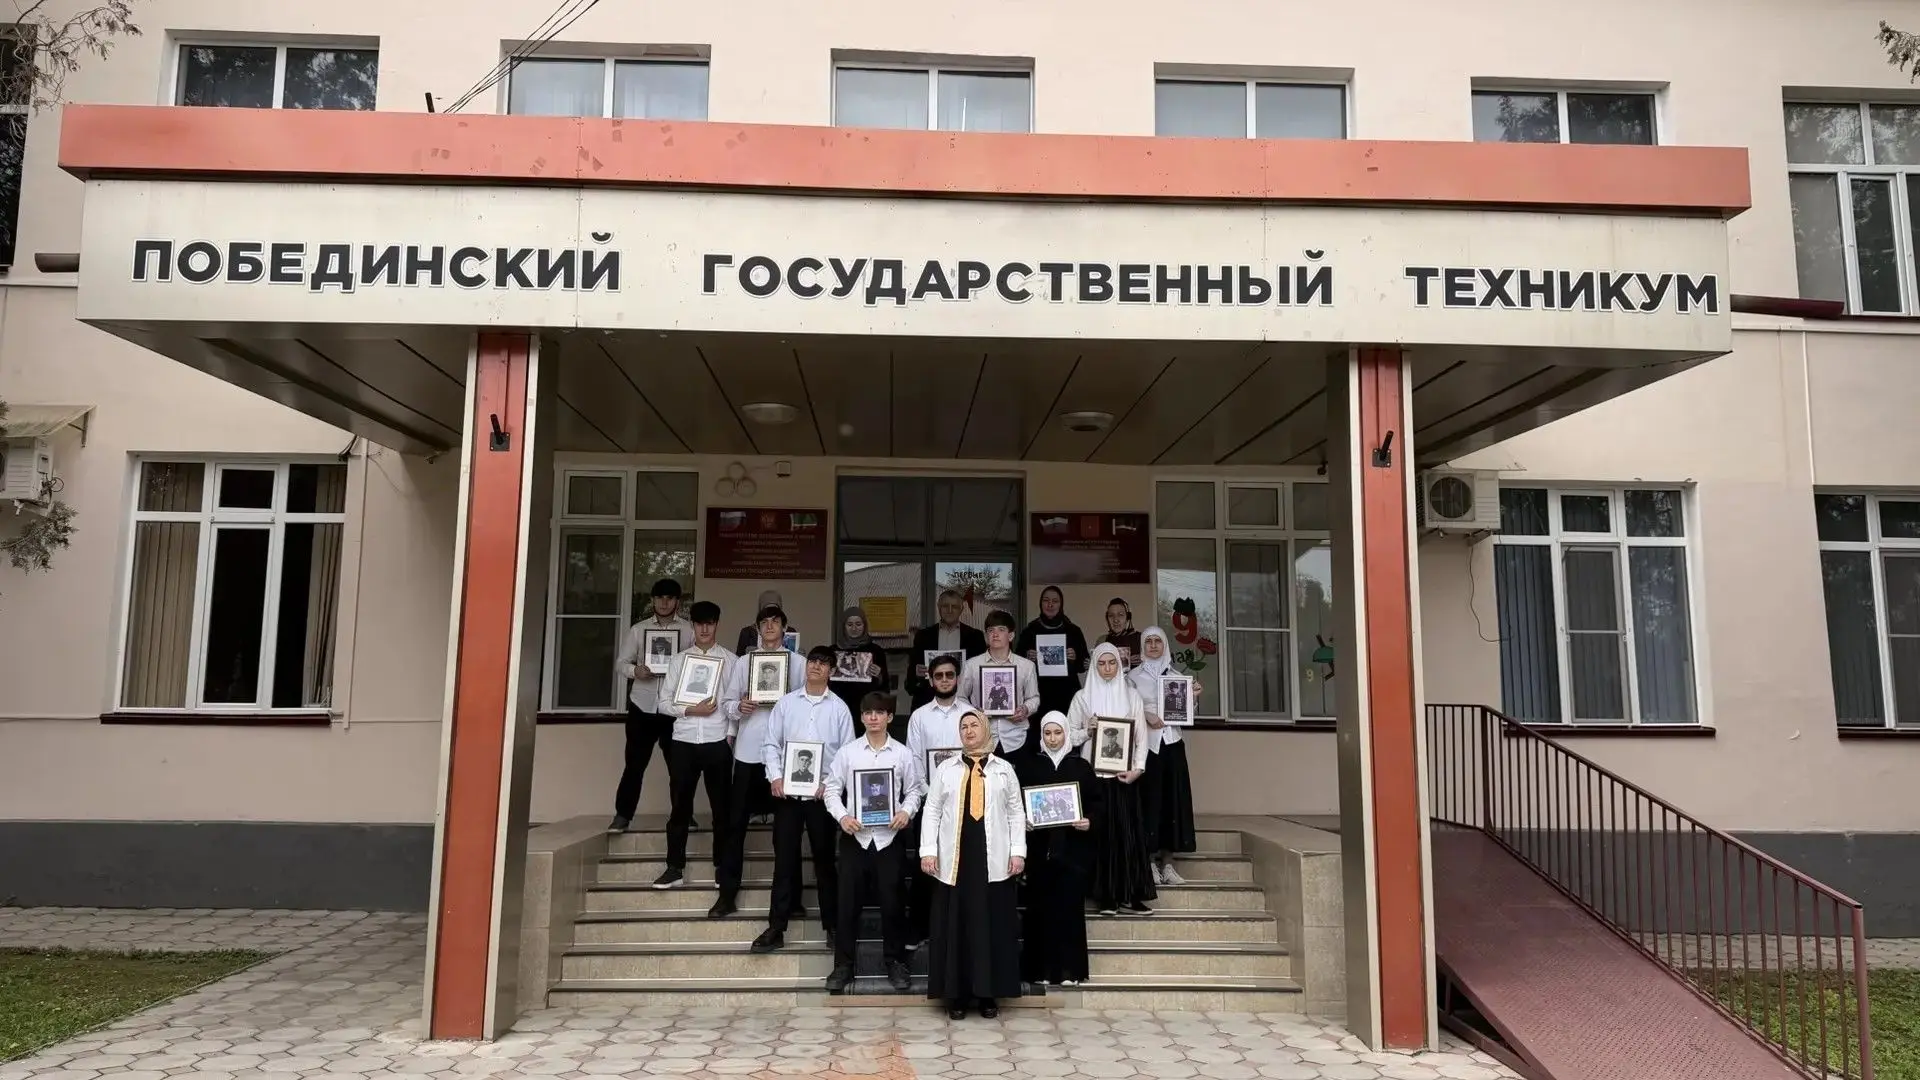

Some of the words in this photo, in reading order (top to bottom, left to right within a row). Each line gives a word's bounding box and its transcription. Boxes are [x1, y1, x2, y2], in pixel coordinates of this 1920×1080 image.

[132, 231, 622, 293] ПОБЕДИНСКИЙ
[702, 248, 1334, 307] ГОСУДАРСТВЕННЫЙ
[1404, 266, 1719, 315] ТЕХНИКУМ
[1173, 606, 1198, 645] 9
